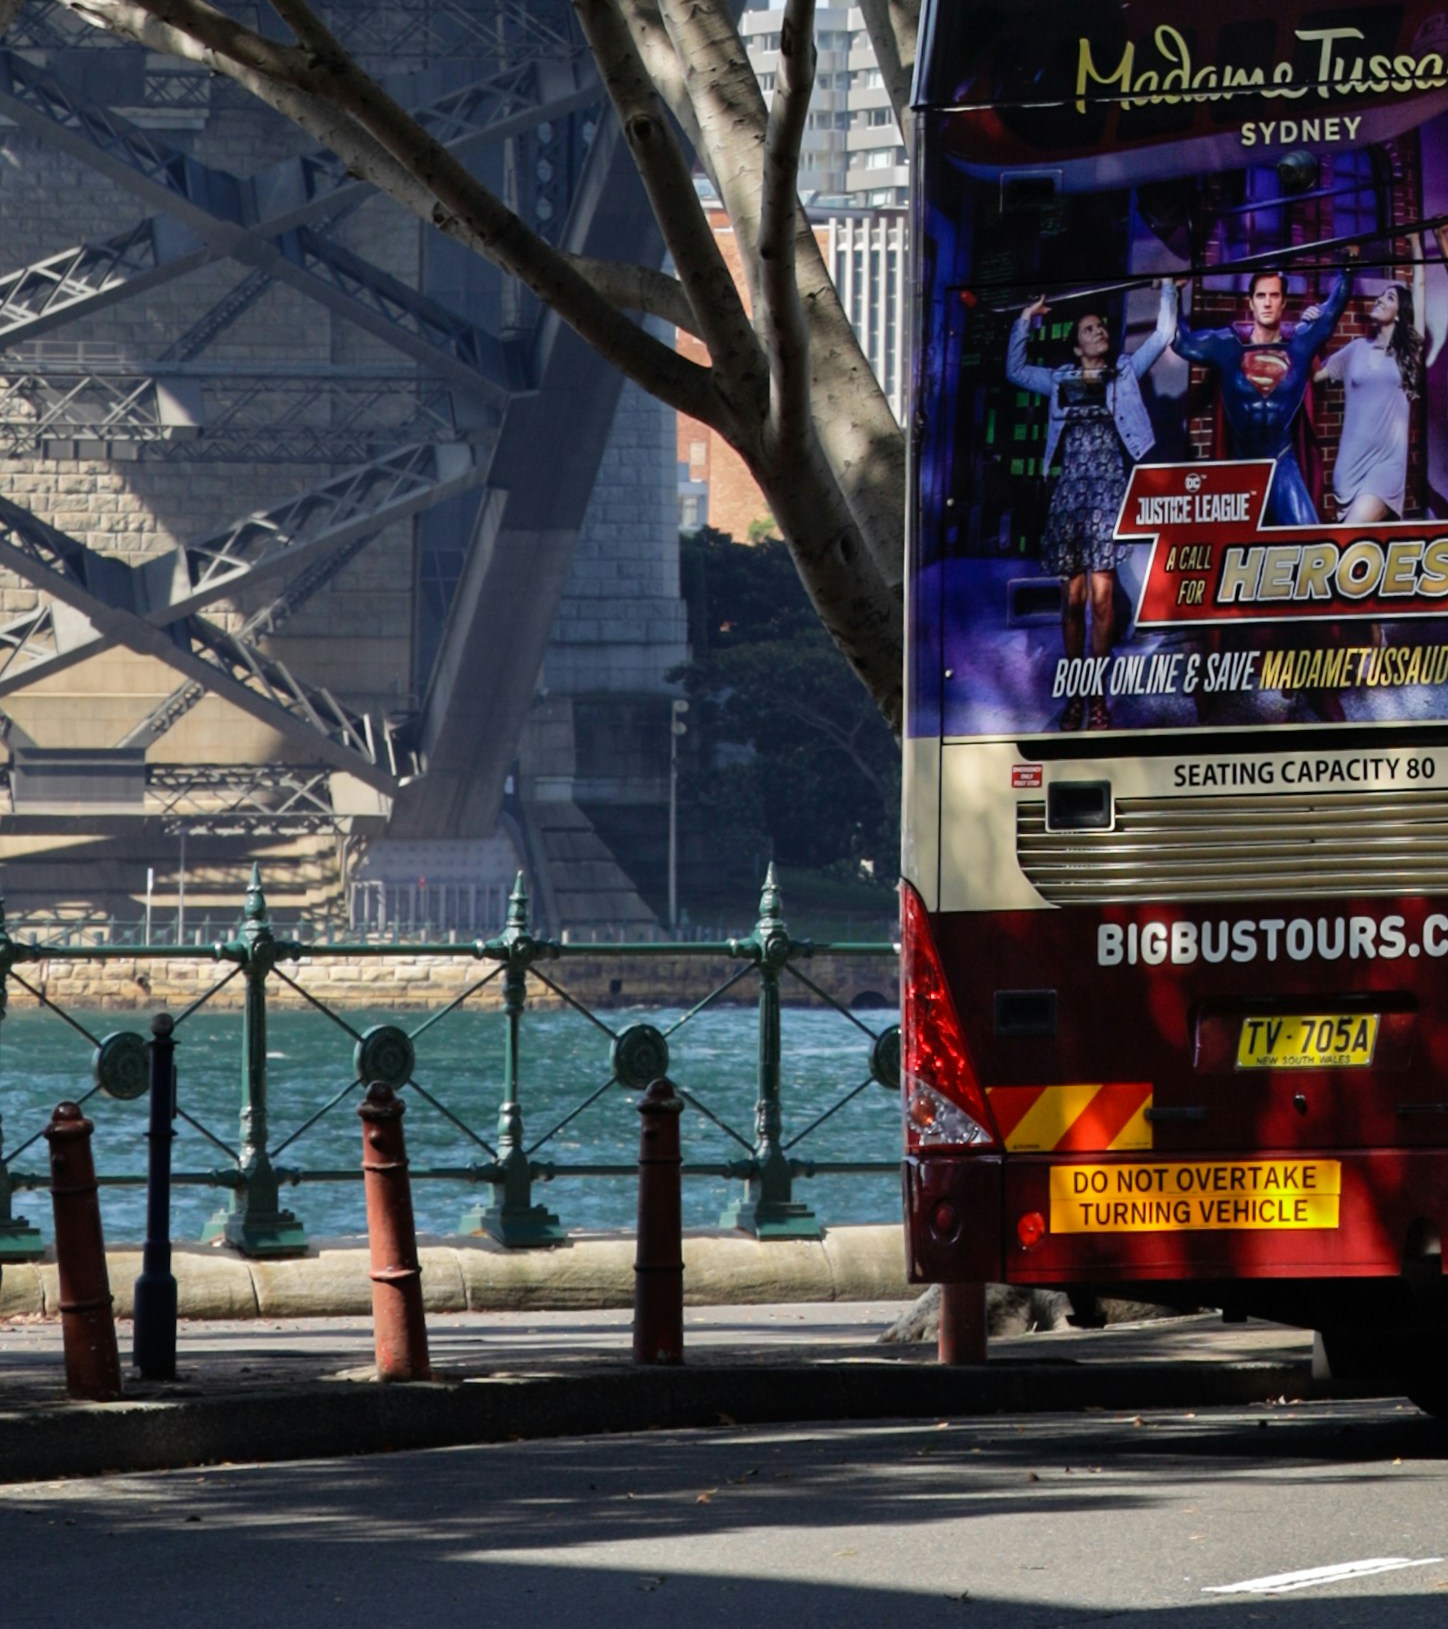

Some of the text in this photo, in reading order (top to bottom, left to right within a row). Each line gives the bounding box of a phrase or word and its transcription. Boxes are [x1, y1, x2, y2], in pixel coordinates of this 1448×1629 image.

[1075, 24, 1308, 113] Madame
[1240, 116, 1363, 147] SYDNEY
[1135, 493, 1251, 526] JUSTICE LEAGUE
[1165, 545, 1212, 572] A CALL
[1177, 579, 1205, 605] FOR
[1052, 658, 1109, 699] BOOK
[1110, 653, 1184, 696] ONLINE
[1182, 652, 1200, 694] &
[1203, 650, 1261, 692] SAVE
[1173, 757, 1435, 787] SEATING CAPACITY 80
[1256, 1055, 1352, 1065] NEW SOUTH WALES
[1073, 1165, 1318, 1194] DO NOT OVERTAKE
[1079, 1199, 1309, 1226] TURNING VEHICLE
